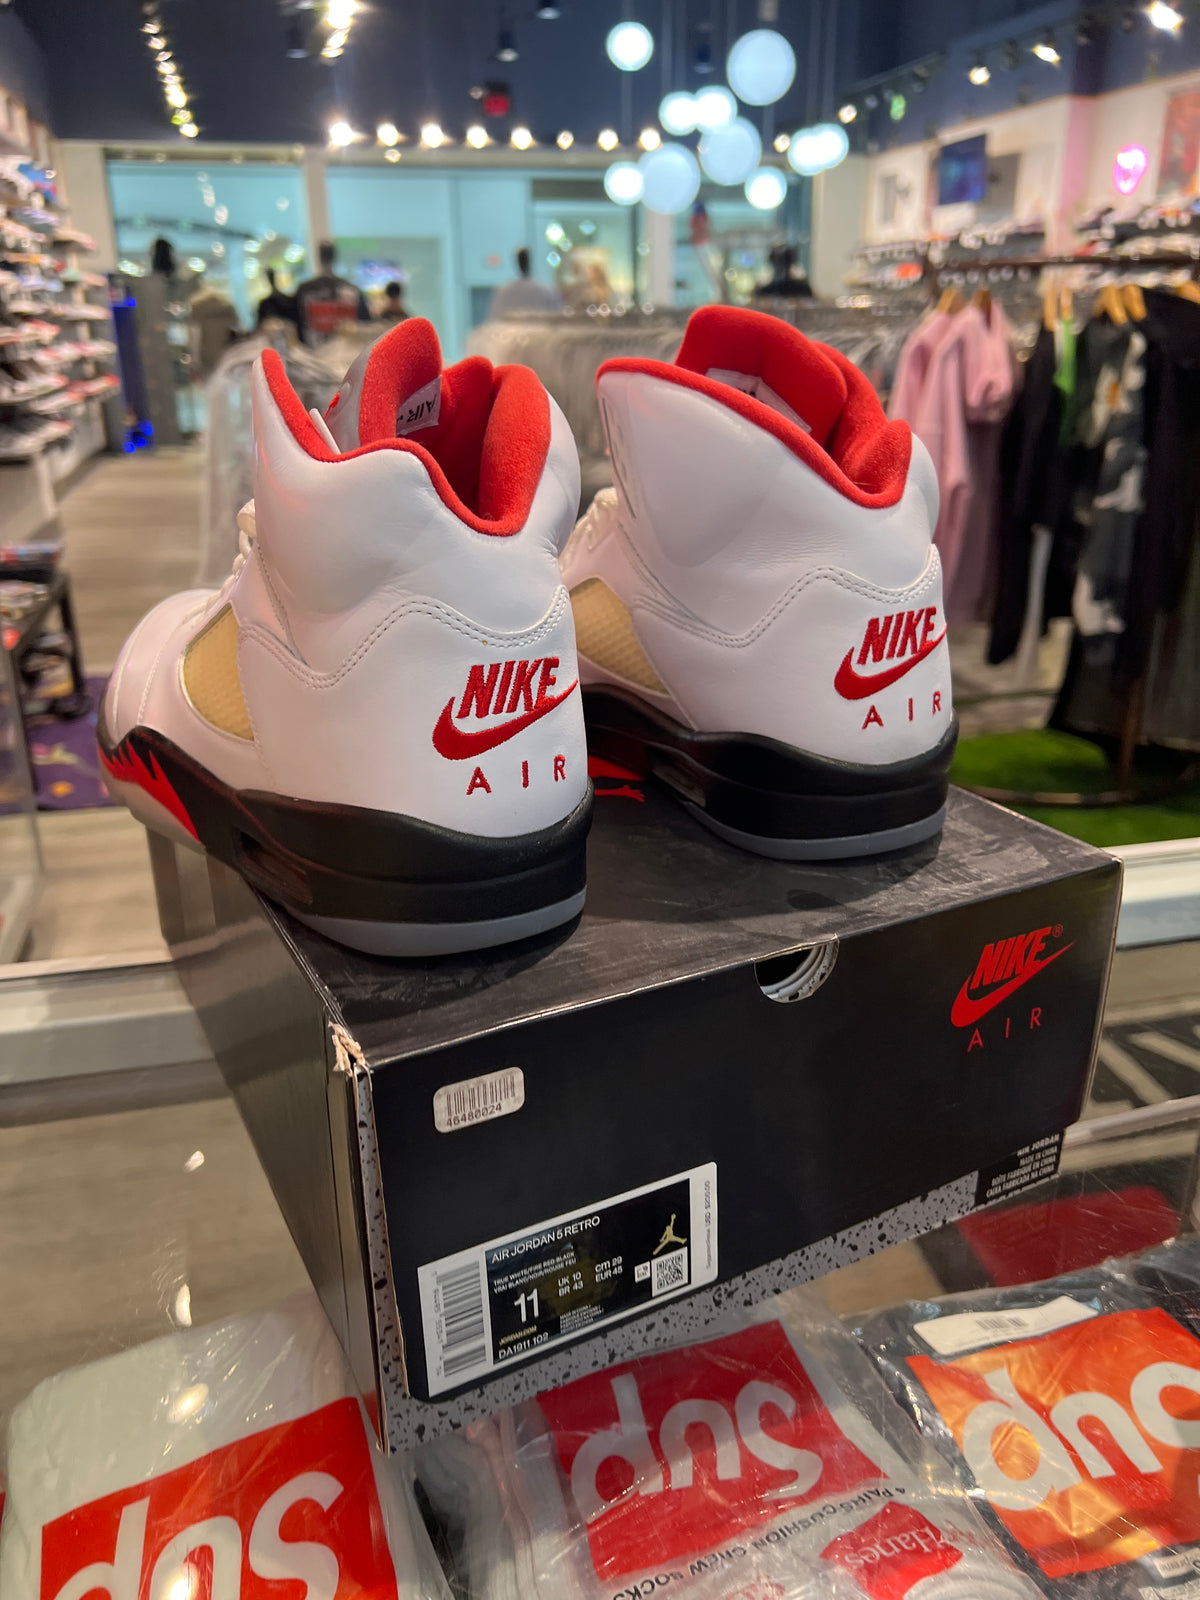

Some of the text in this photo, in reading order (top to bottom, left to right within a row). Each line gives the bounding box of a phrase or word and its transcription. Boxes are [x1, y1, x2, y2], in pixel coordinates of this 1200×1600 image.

[857, 606, 936, 666] NIKE
[455, 657, 560, 719] NIKE
[1031, 1133, 1060, 1152] JORDAN
[491, 1215, 601, 1264] AIR JORDAN 5 RETRO
[557, 1271, 582, 1287] UK 10
[595, 1269, 612, 1283] EUR
[514, 1287, 540, 1323] 11
[844, 1526, 944, 1568] Hanes
